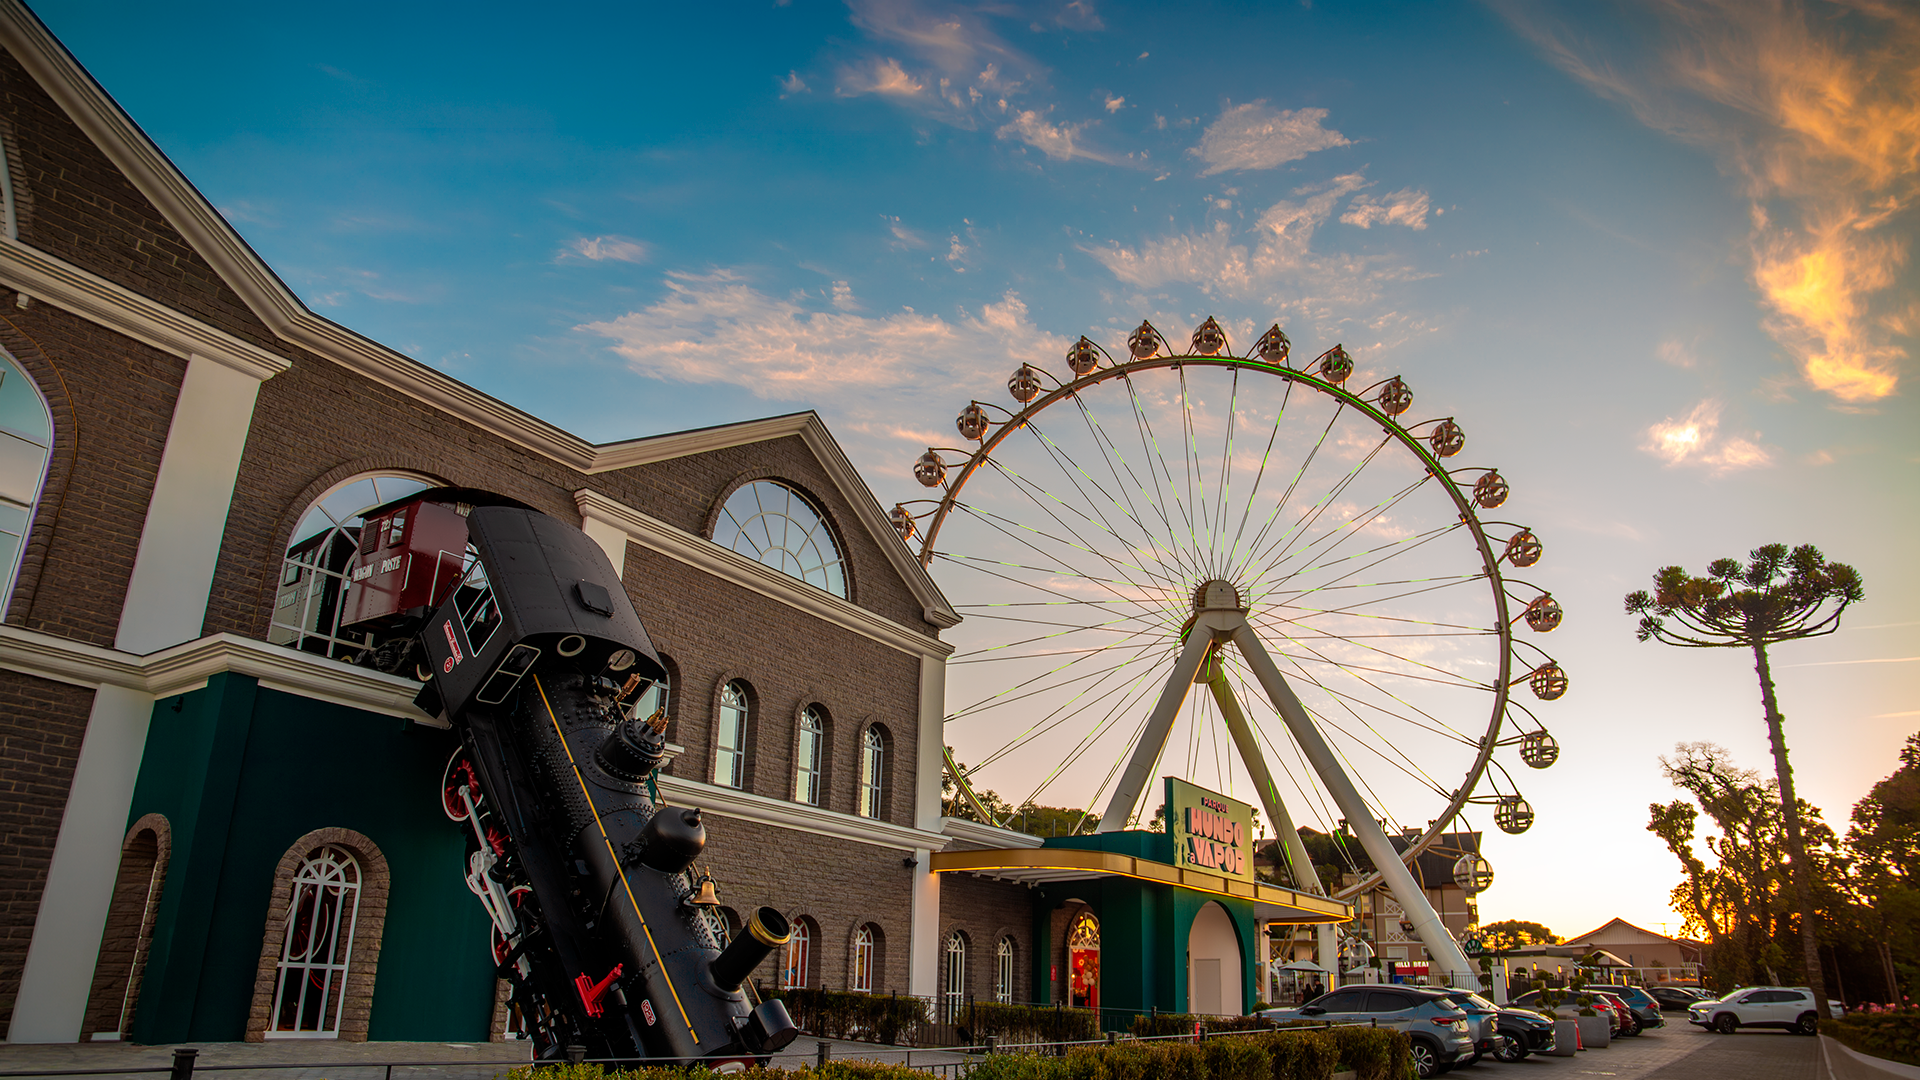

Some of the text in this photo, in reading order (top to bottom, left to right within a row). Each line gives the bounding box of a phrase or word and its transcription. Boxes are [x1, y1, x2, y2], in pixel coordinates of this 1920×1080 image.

[1202, 797, 1229, 813] PARQUE
[1188, 807, 1244, 848] MUNDO
[1189, 837, 1245, 875] a VAPOR
